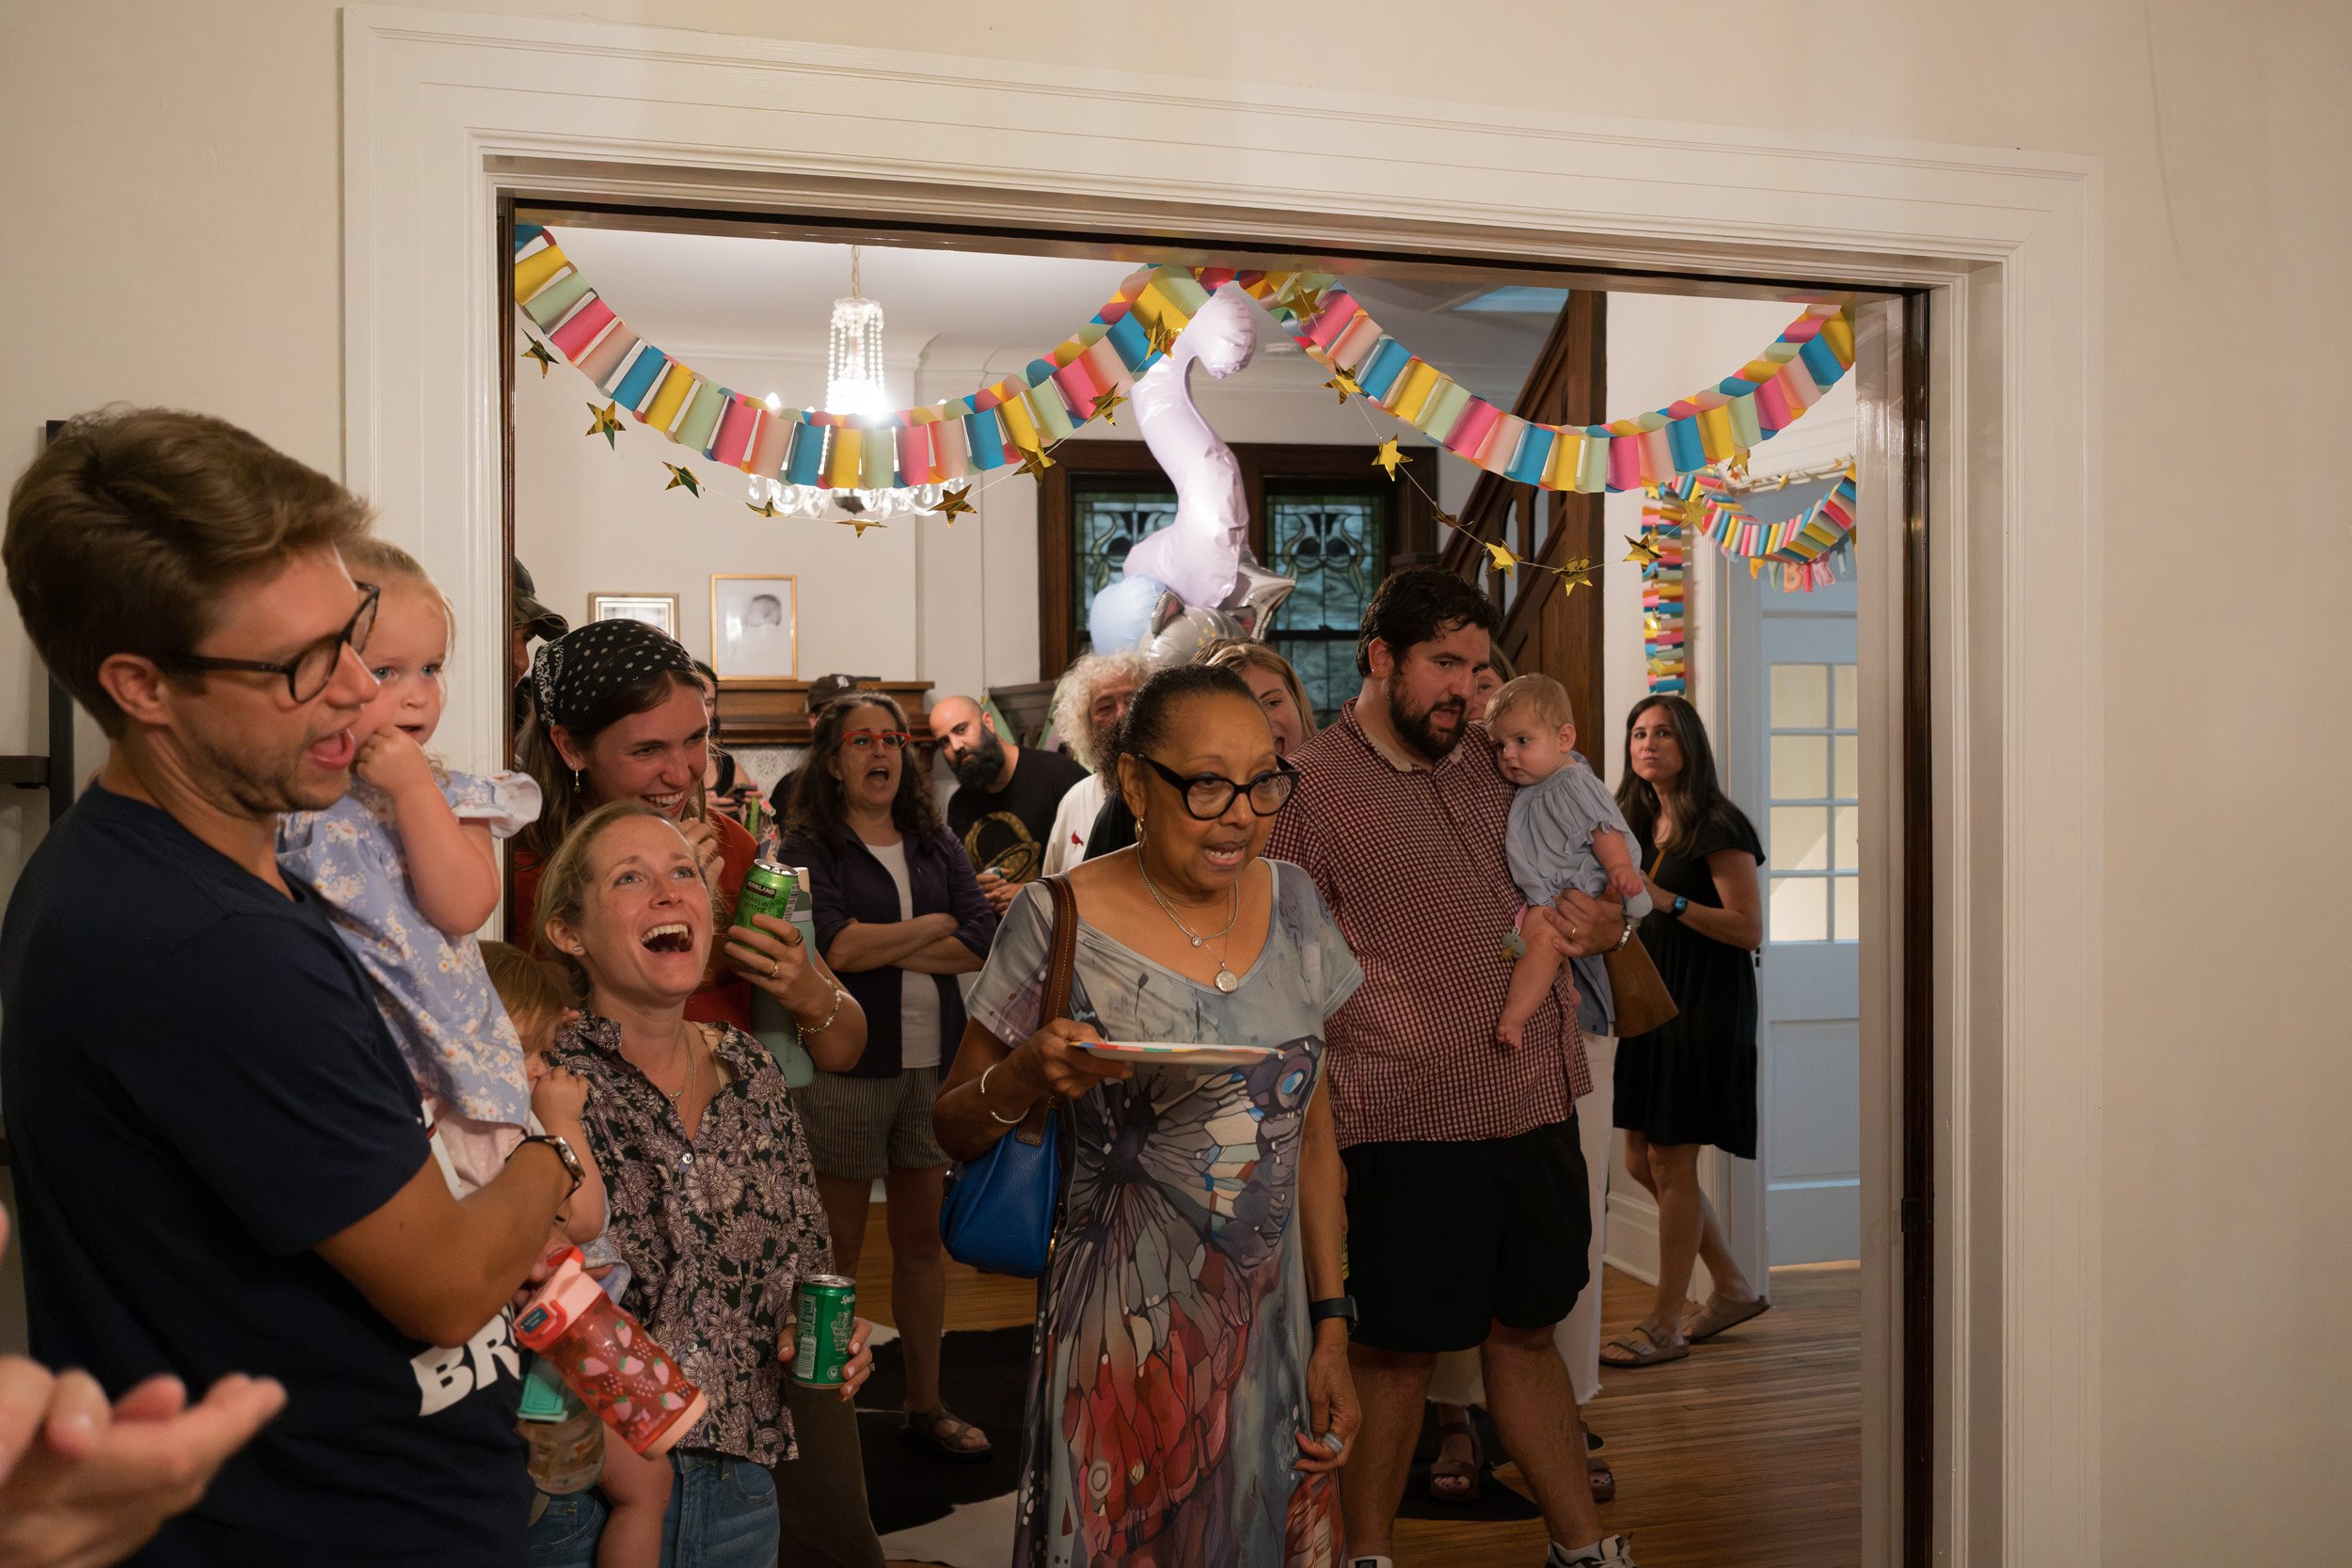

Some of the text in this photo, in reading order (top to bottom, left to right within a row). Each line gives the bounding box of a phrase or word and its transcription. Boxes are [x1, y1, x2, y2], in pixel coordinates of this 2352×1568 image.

[1783, 533, 1852, 594] BIRT
[747, 880, 775, 895] KIRKLAND
[410, 1302, 521, 1418] BR
